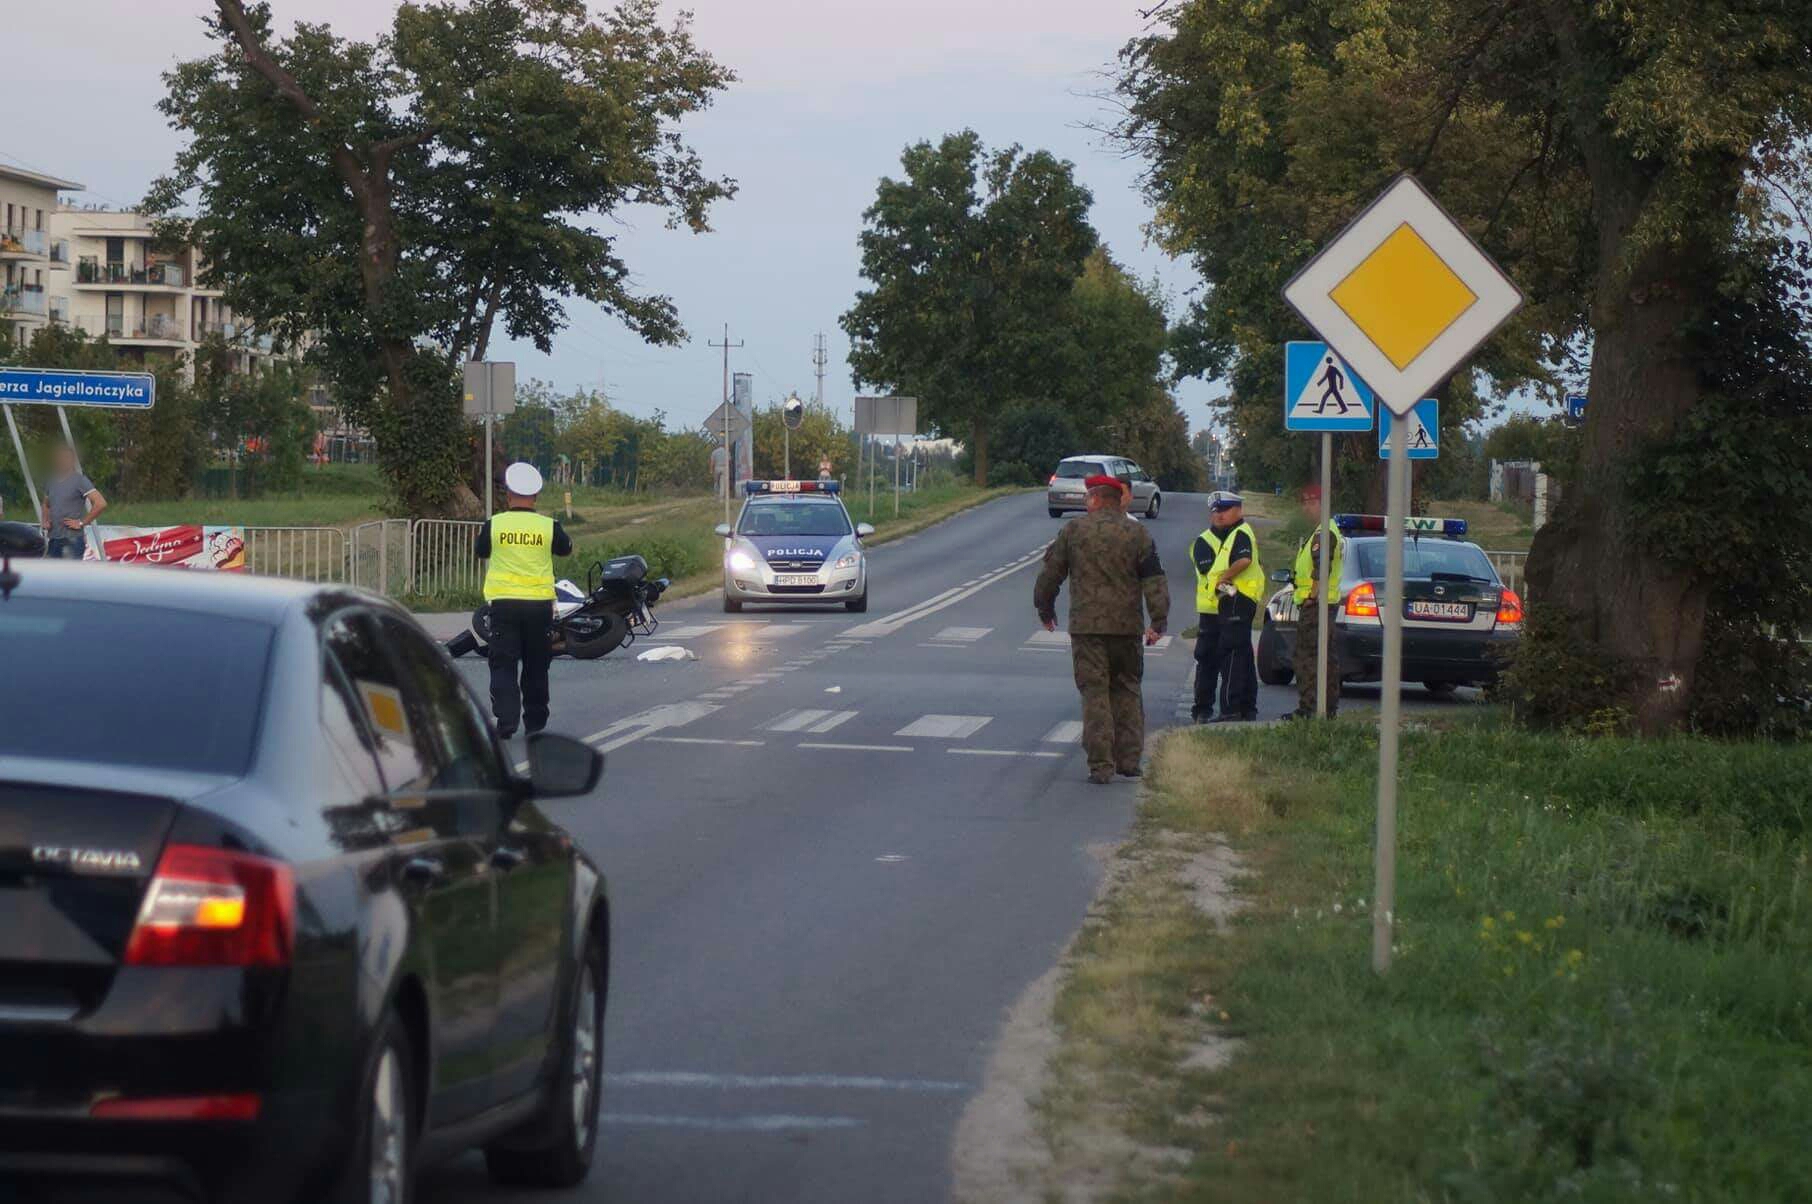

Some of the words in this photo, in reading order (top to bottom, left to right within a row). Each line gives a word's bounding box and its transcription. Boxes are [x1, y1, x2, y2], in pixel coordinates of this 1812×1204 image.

[36, 380, 143, 400] Jagiellończyka
[500, 532, 543, 546] POLICJA
[767, 548, 823, 556] POLICJA
[1414, 603, 1430, 614] UA
